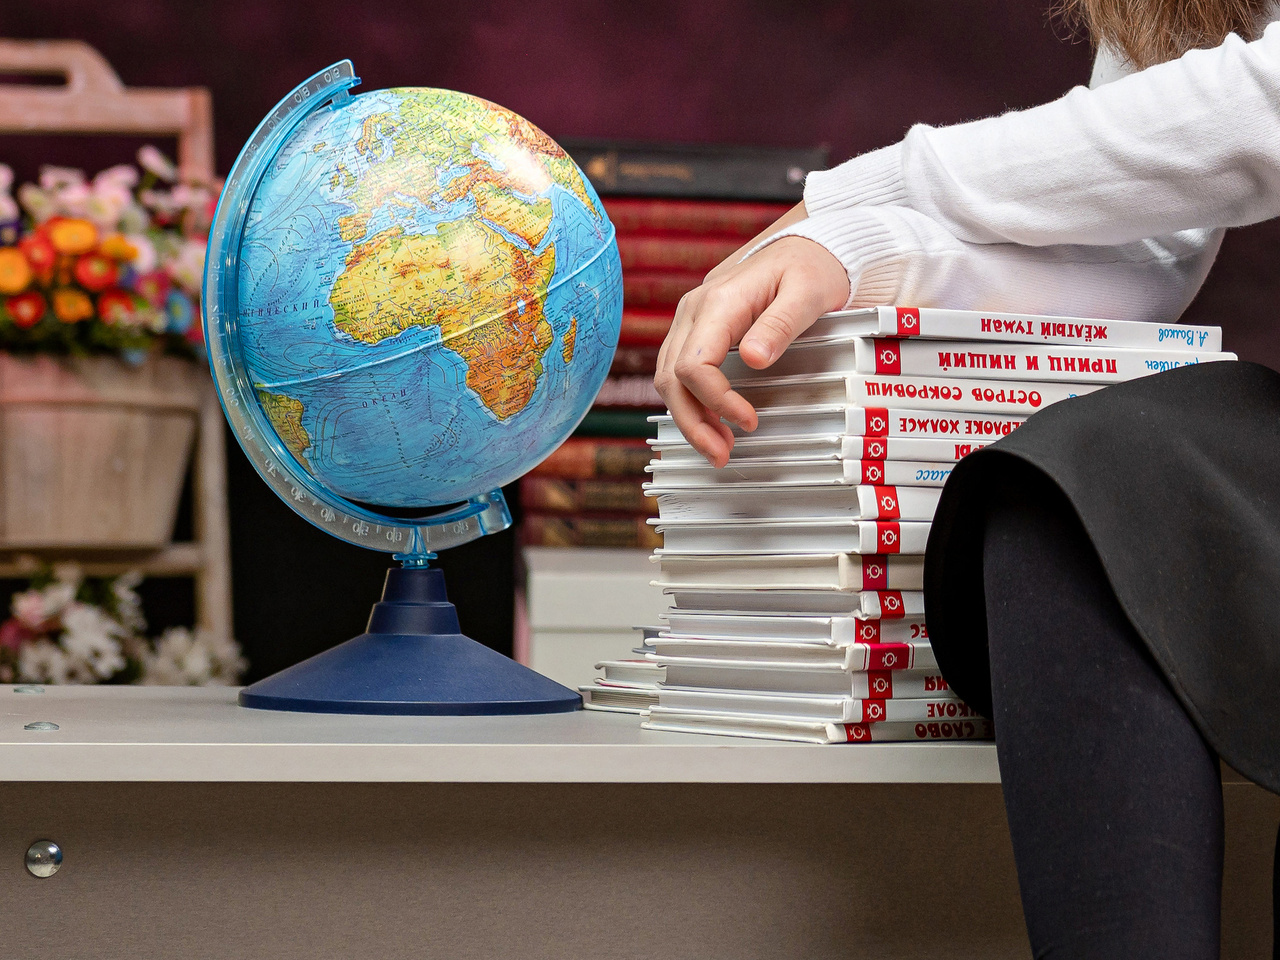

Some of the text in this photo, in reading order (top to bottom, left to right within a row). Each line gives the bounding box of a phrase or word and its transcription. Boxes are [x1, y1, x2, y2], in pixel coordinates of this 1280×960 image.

[1040, 322, 1108, 343] ЖЁЛТЫЙ
[938, 351, 1016, 372] НИЩИЙ
[1025, 355, 1039, 371] И
[1047, 355, 1118, 374] ПРИНЦ
[863, 380, 1043, 408] ОСТРОВ СОКРОВИЩ
[899, 417, 1025, 437] ЕРЛОКЕ ХОЛМСЕ
[915, 469, 953, 482] ласс
[909, 623, 930, 639] ЕС
[924, 676, 949, 691] ИЯ
[914, 721, 975, 739] СЛОВО
